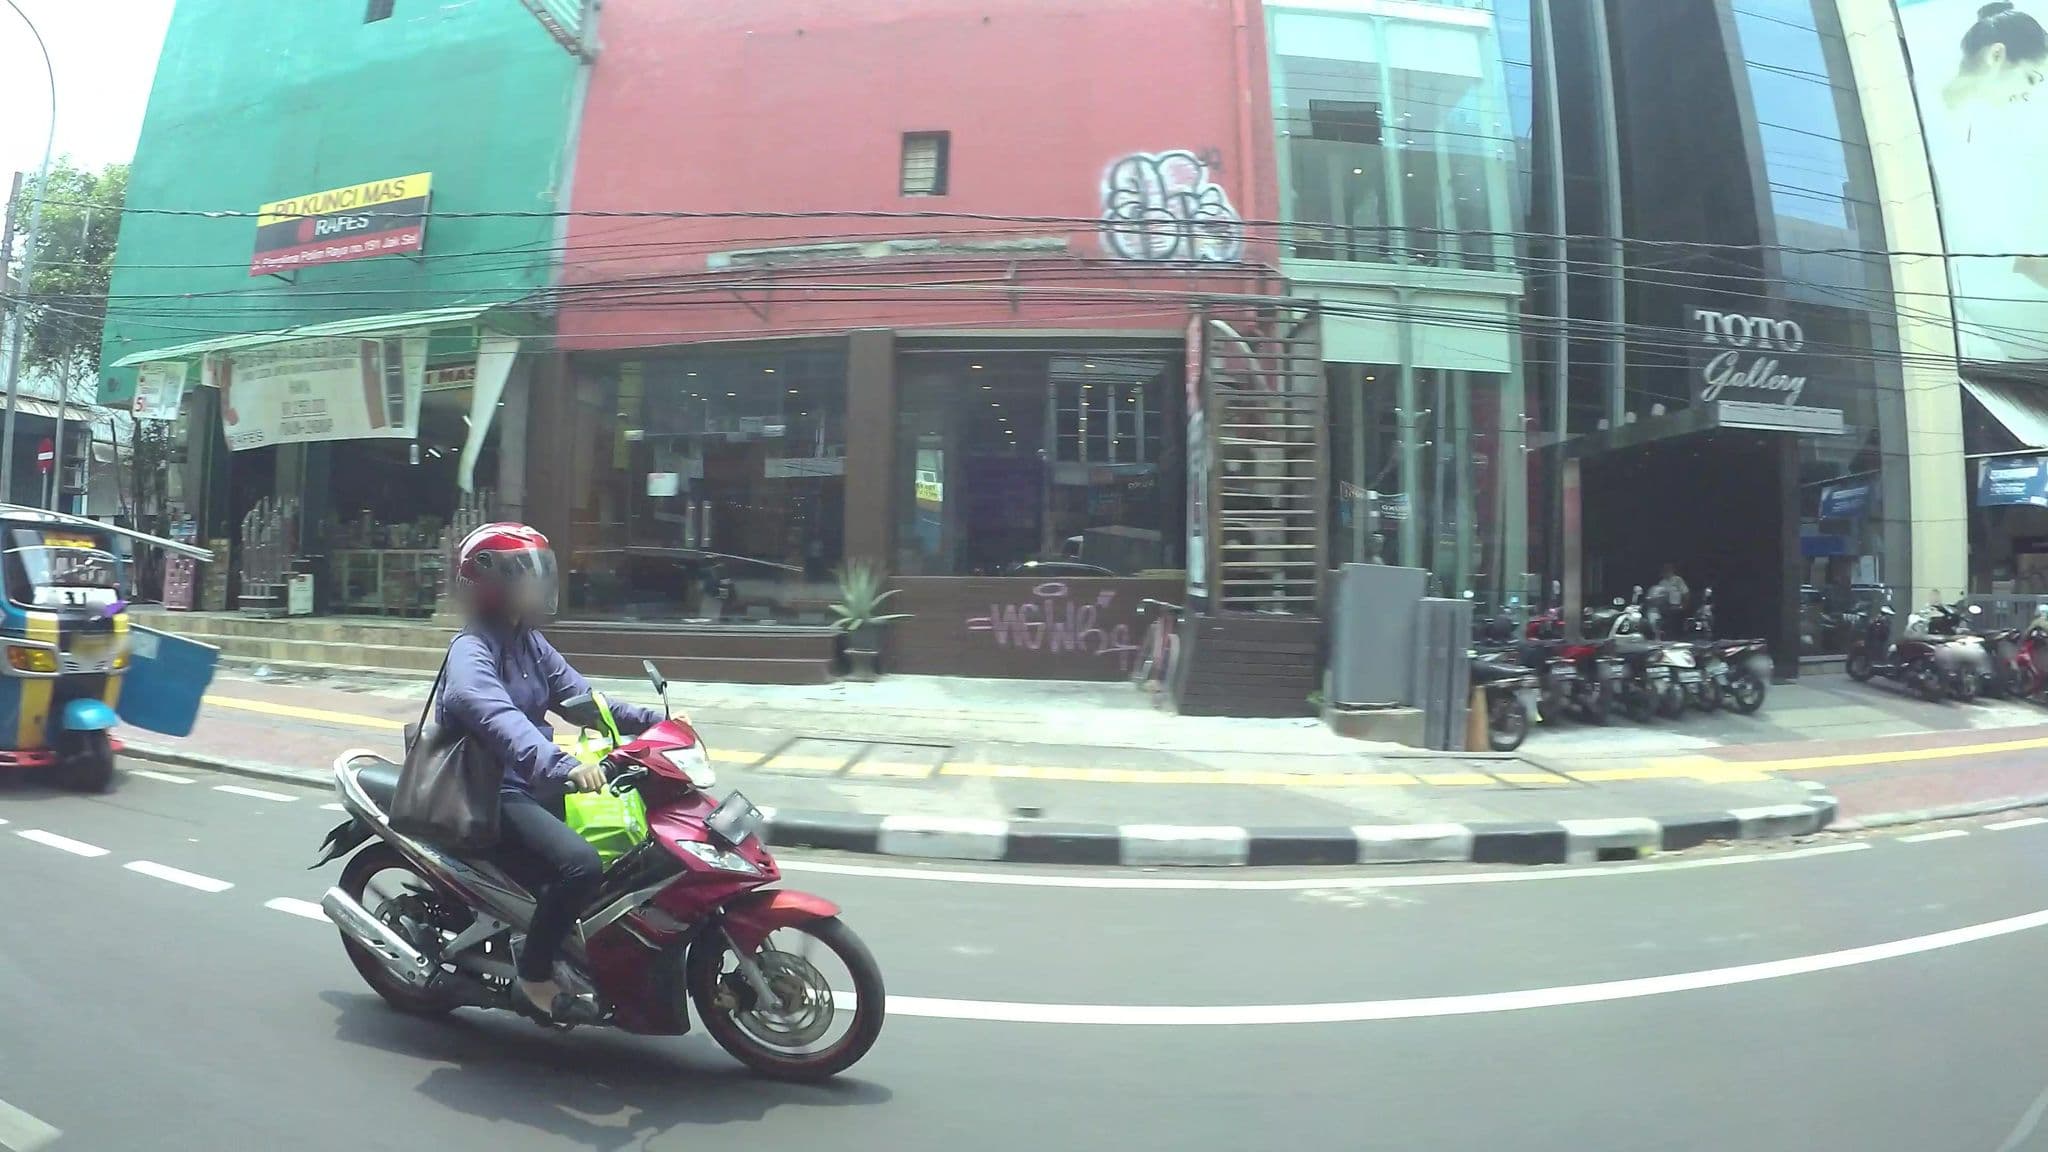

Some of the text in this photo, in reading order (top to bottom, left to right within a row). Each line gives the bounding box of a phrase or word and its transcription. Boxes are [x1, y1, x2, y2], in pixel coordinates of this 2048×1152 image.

[302, 188, 358, 214] KUNCI
[363, 180, 406, 203] MAS
[314, 214, 370, 236] RAFES
[1694, 309, 1804, 351] TOTO
[1700, 350, 1807, 406] Gallery
